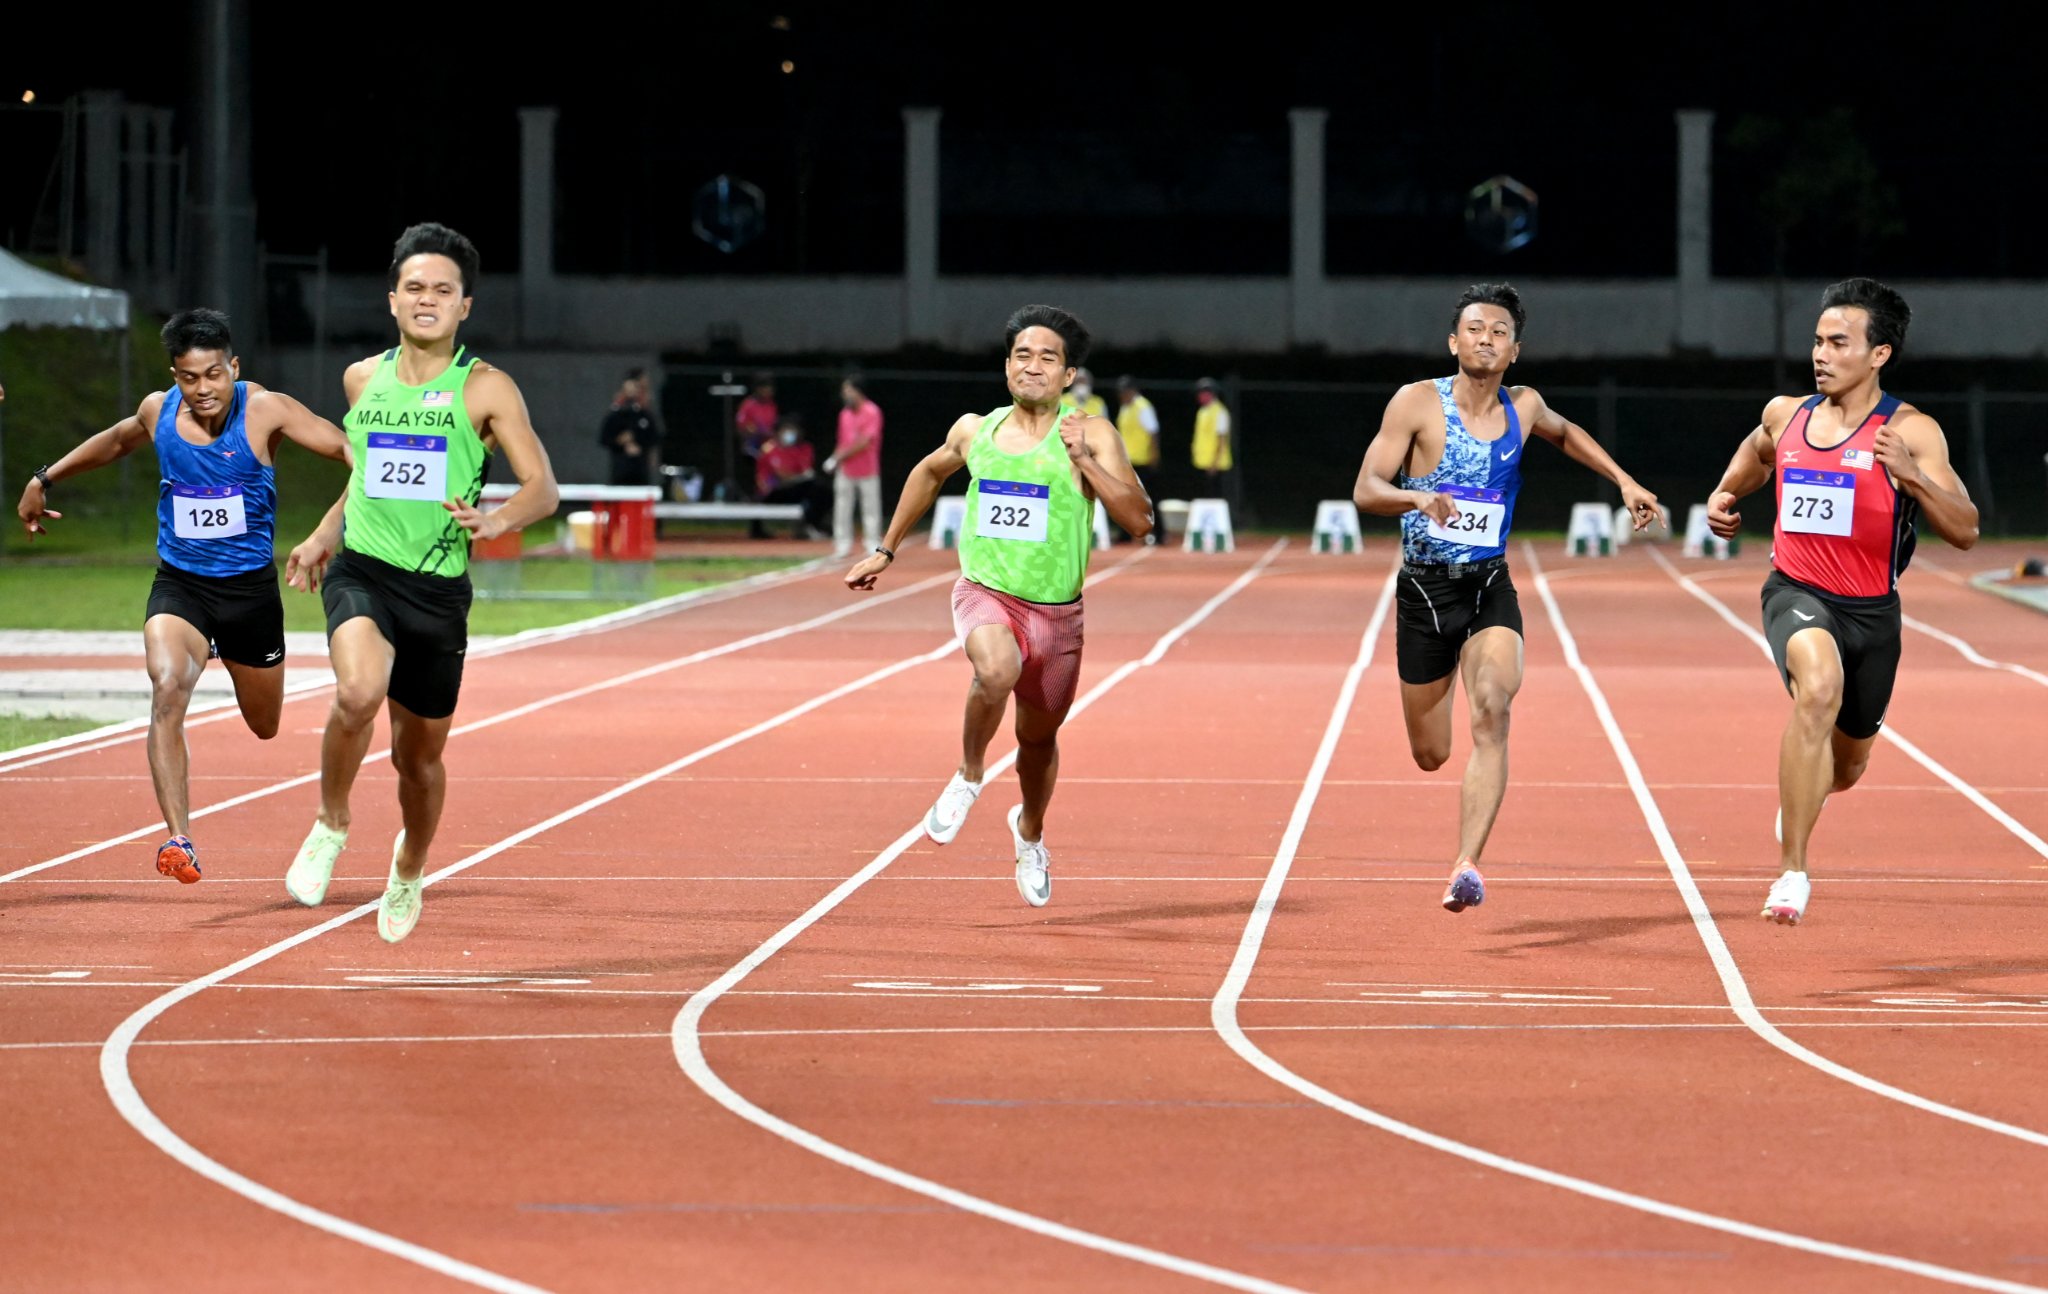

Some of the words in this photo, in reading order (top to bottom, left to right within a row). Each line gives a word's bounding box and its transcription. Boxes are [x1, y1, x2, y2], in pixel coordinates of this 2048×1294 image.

[356, 410, 456, 430] MALAYSIA
[380, 461, 426, 486] 252
[188, 508, 229, 528] 128
[989, 505, 1031, 528] 232
[1791, 496, 1834, 521] 273
[1447, 511, 1489, 534] 234
